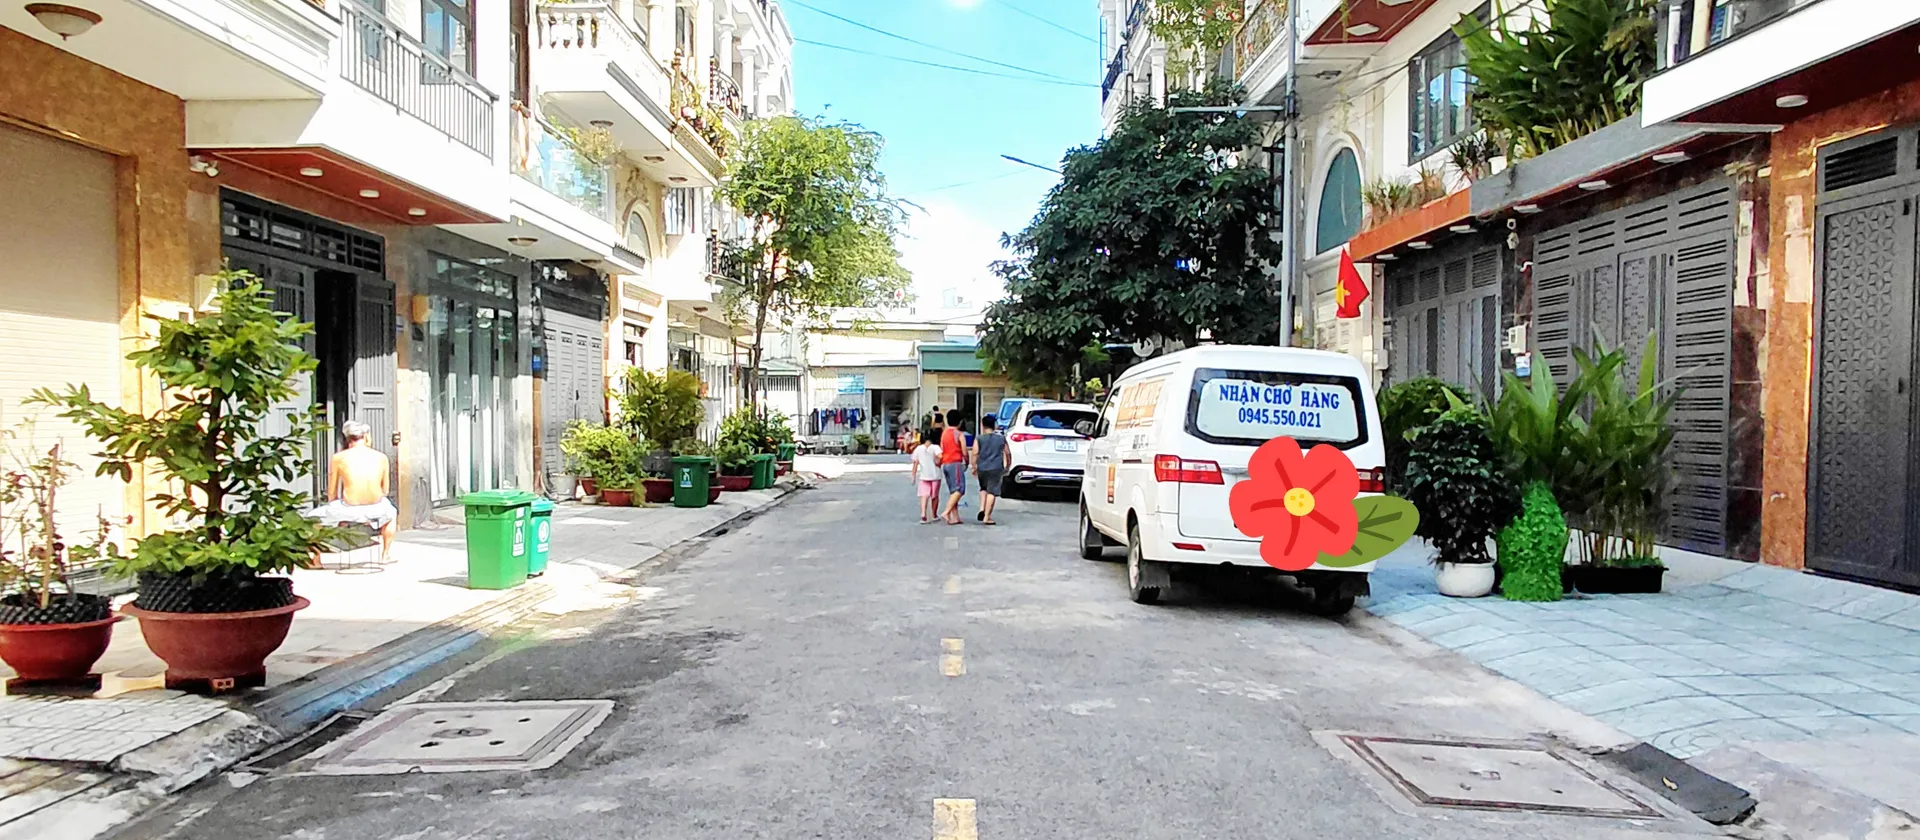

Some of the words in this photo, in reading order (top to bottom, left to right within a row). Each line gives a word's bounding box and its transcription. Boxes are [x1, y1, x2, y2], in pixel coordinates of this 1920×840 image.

[1219, 381, 1261, 405] NHẬN
[1301, 387, 1340, 409] HÀNG
[1238, 407, 1321, 428] 0945.550.021
